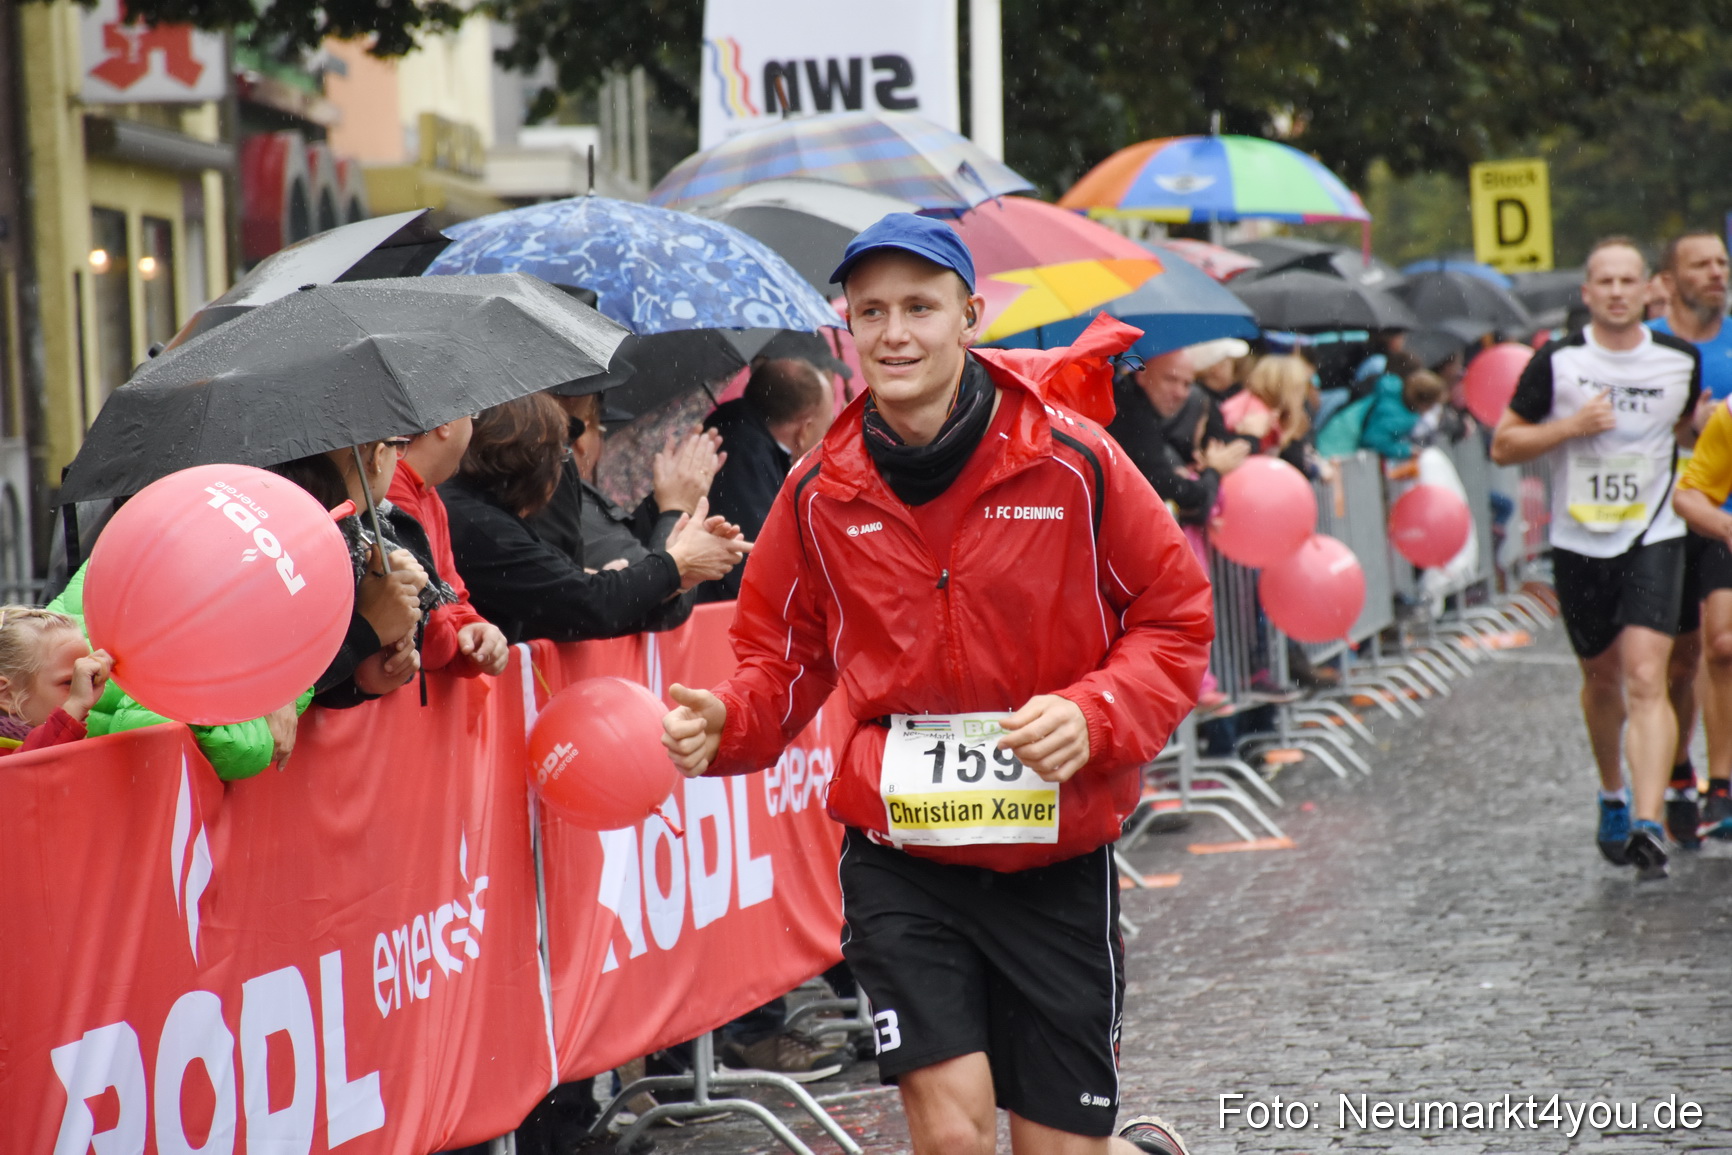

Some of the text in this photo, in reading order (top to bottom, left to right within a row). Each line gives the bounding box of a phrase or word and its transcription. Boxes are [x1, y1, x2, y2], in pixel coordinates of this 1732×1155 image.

[1496, 198, 1529, 247] D
[1588, 474, 1638, 502] 155
[984, 506, 1064, 520] 1. FC DEINING
[860, 521, 883, 534] JAKO
[923, 740, 1024, 784] 159
[888, 784, 896, 793] B
[889, 797, 1056, 824] Christian Xaver
[1091, 1096, 1110, 1107] JAKO
